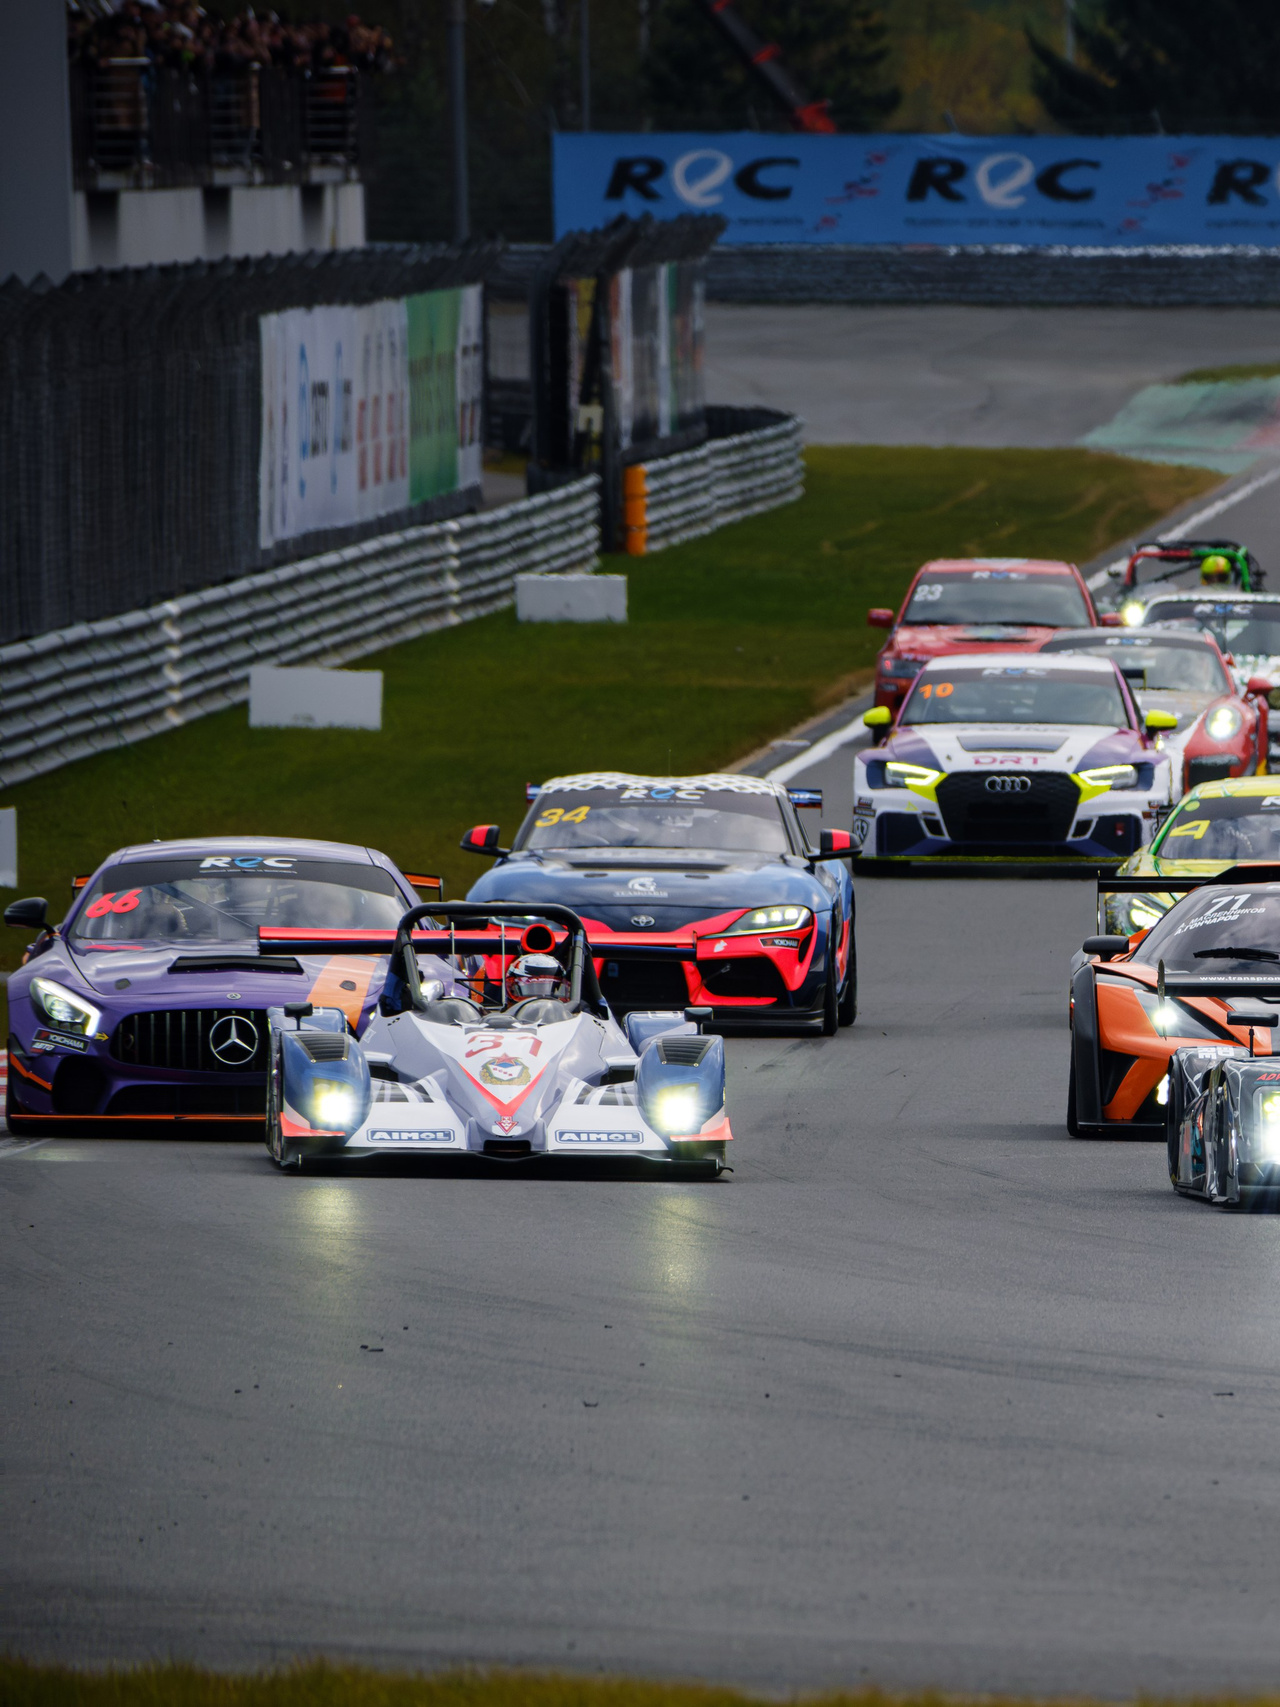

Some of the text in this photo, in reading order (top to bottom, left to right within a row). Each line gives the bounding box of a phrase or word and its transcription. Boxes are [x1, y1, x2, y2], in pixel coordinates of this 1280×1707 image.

[914, 585, 942, 601] 23
[919, 683, 954, 700] 10
[535, 805, 591, 828] 34
[1169, 820, 1211, 840] 4
[86, 889, 143, 919] 66
[1204, 893, 1251, 916] 71
[465, 1034, 543, 1058] 31
[371, 1131, 451, 1141] AIMOL
[560, 1132, 640, 1142] AIMOL
